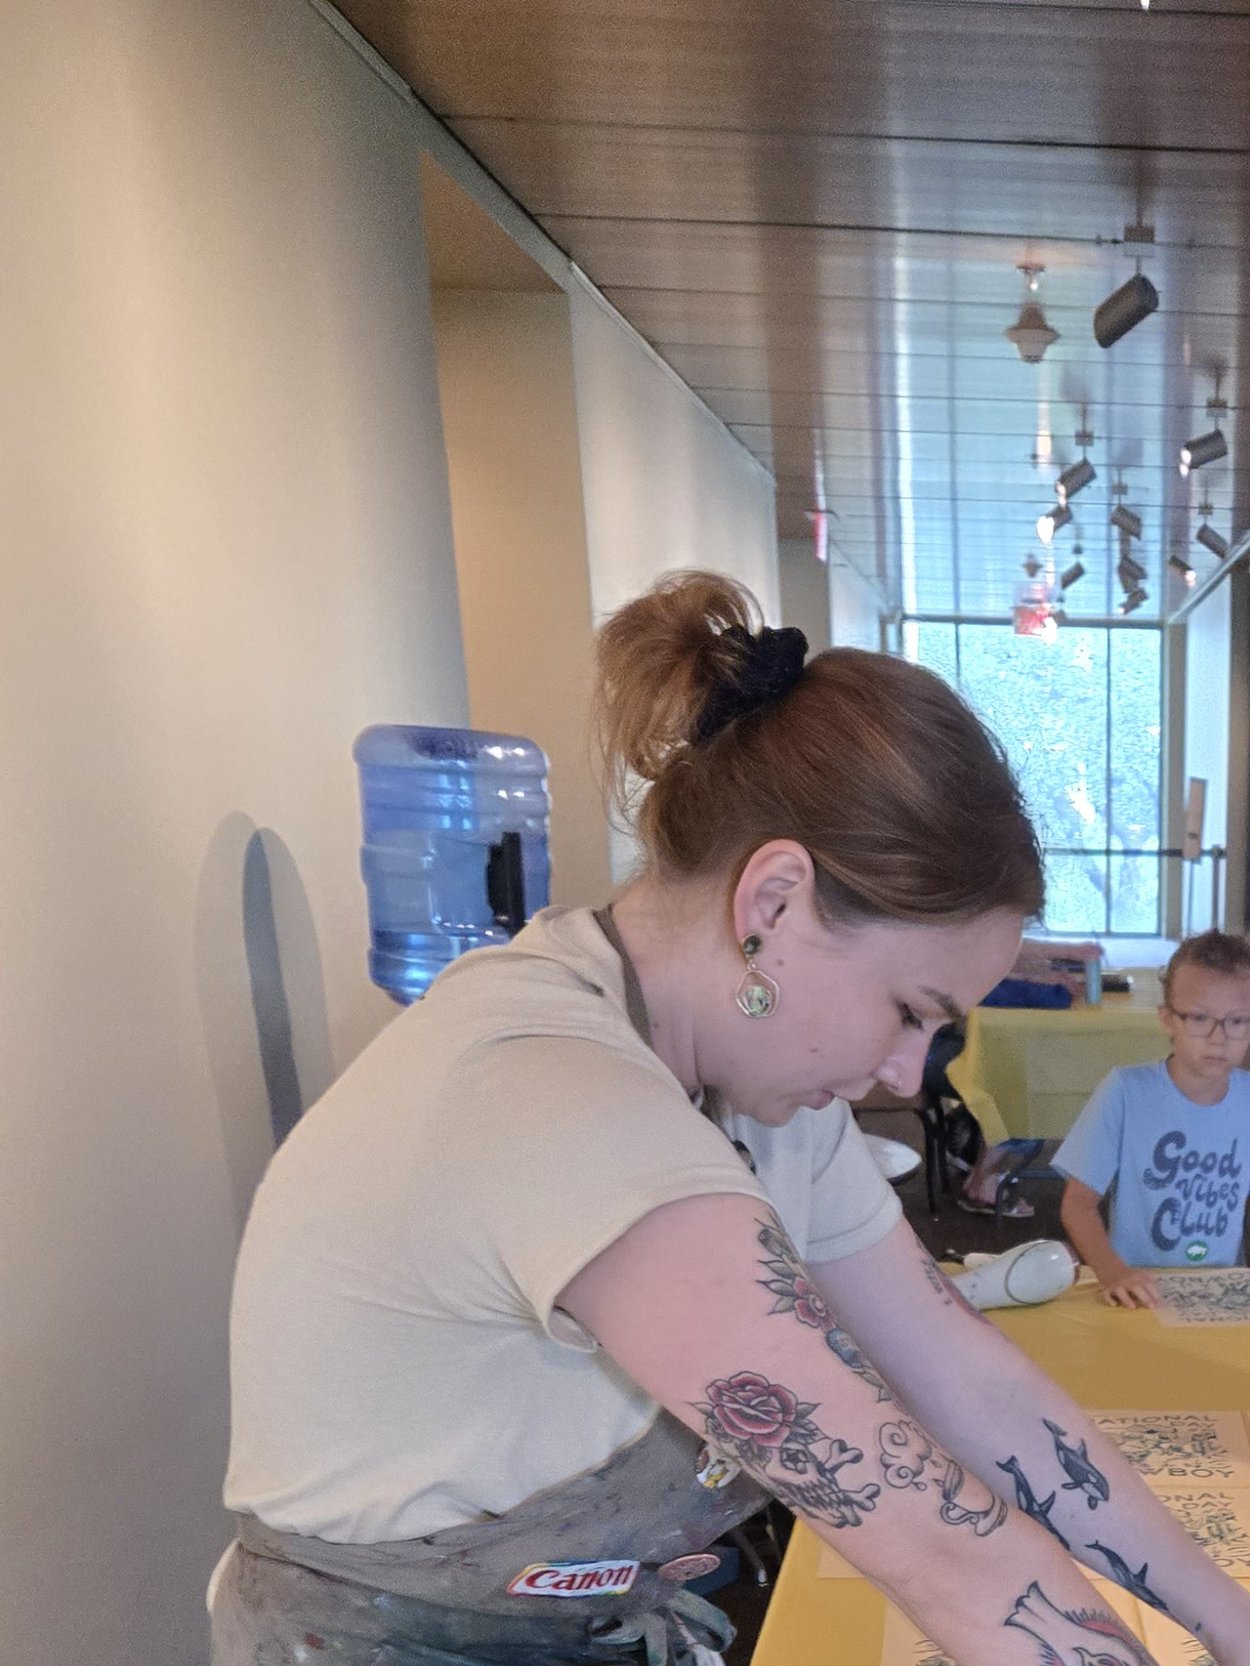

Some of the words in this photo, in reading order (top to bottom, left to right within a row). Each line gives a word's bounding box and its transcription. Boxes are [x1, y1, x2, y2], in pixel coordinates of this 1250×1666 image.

[1143, 1130, 1242, 1190] Good
[1175, 1174, 1240, 1212] Vibes
[1151, 1197, 1228, 1251] Club
[1092, 1415, 1218, 1425] ATIONAL
[526, 1564, 634, 1591] Canon
